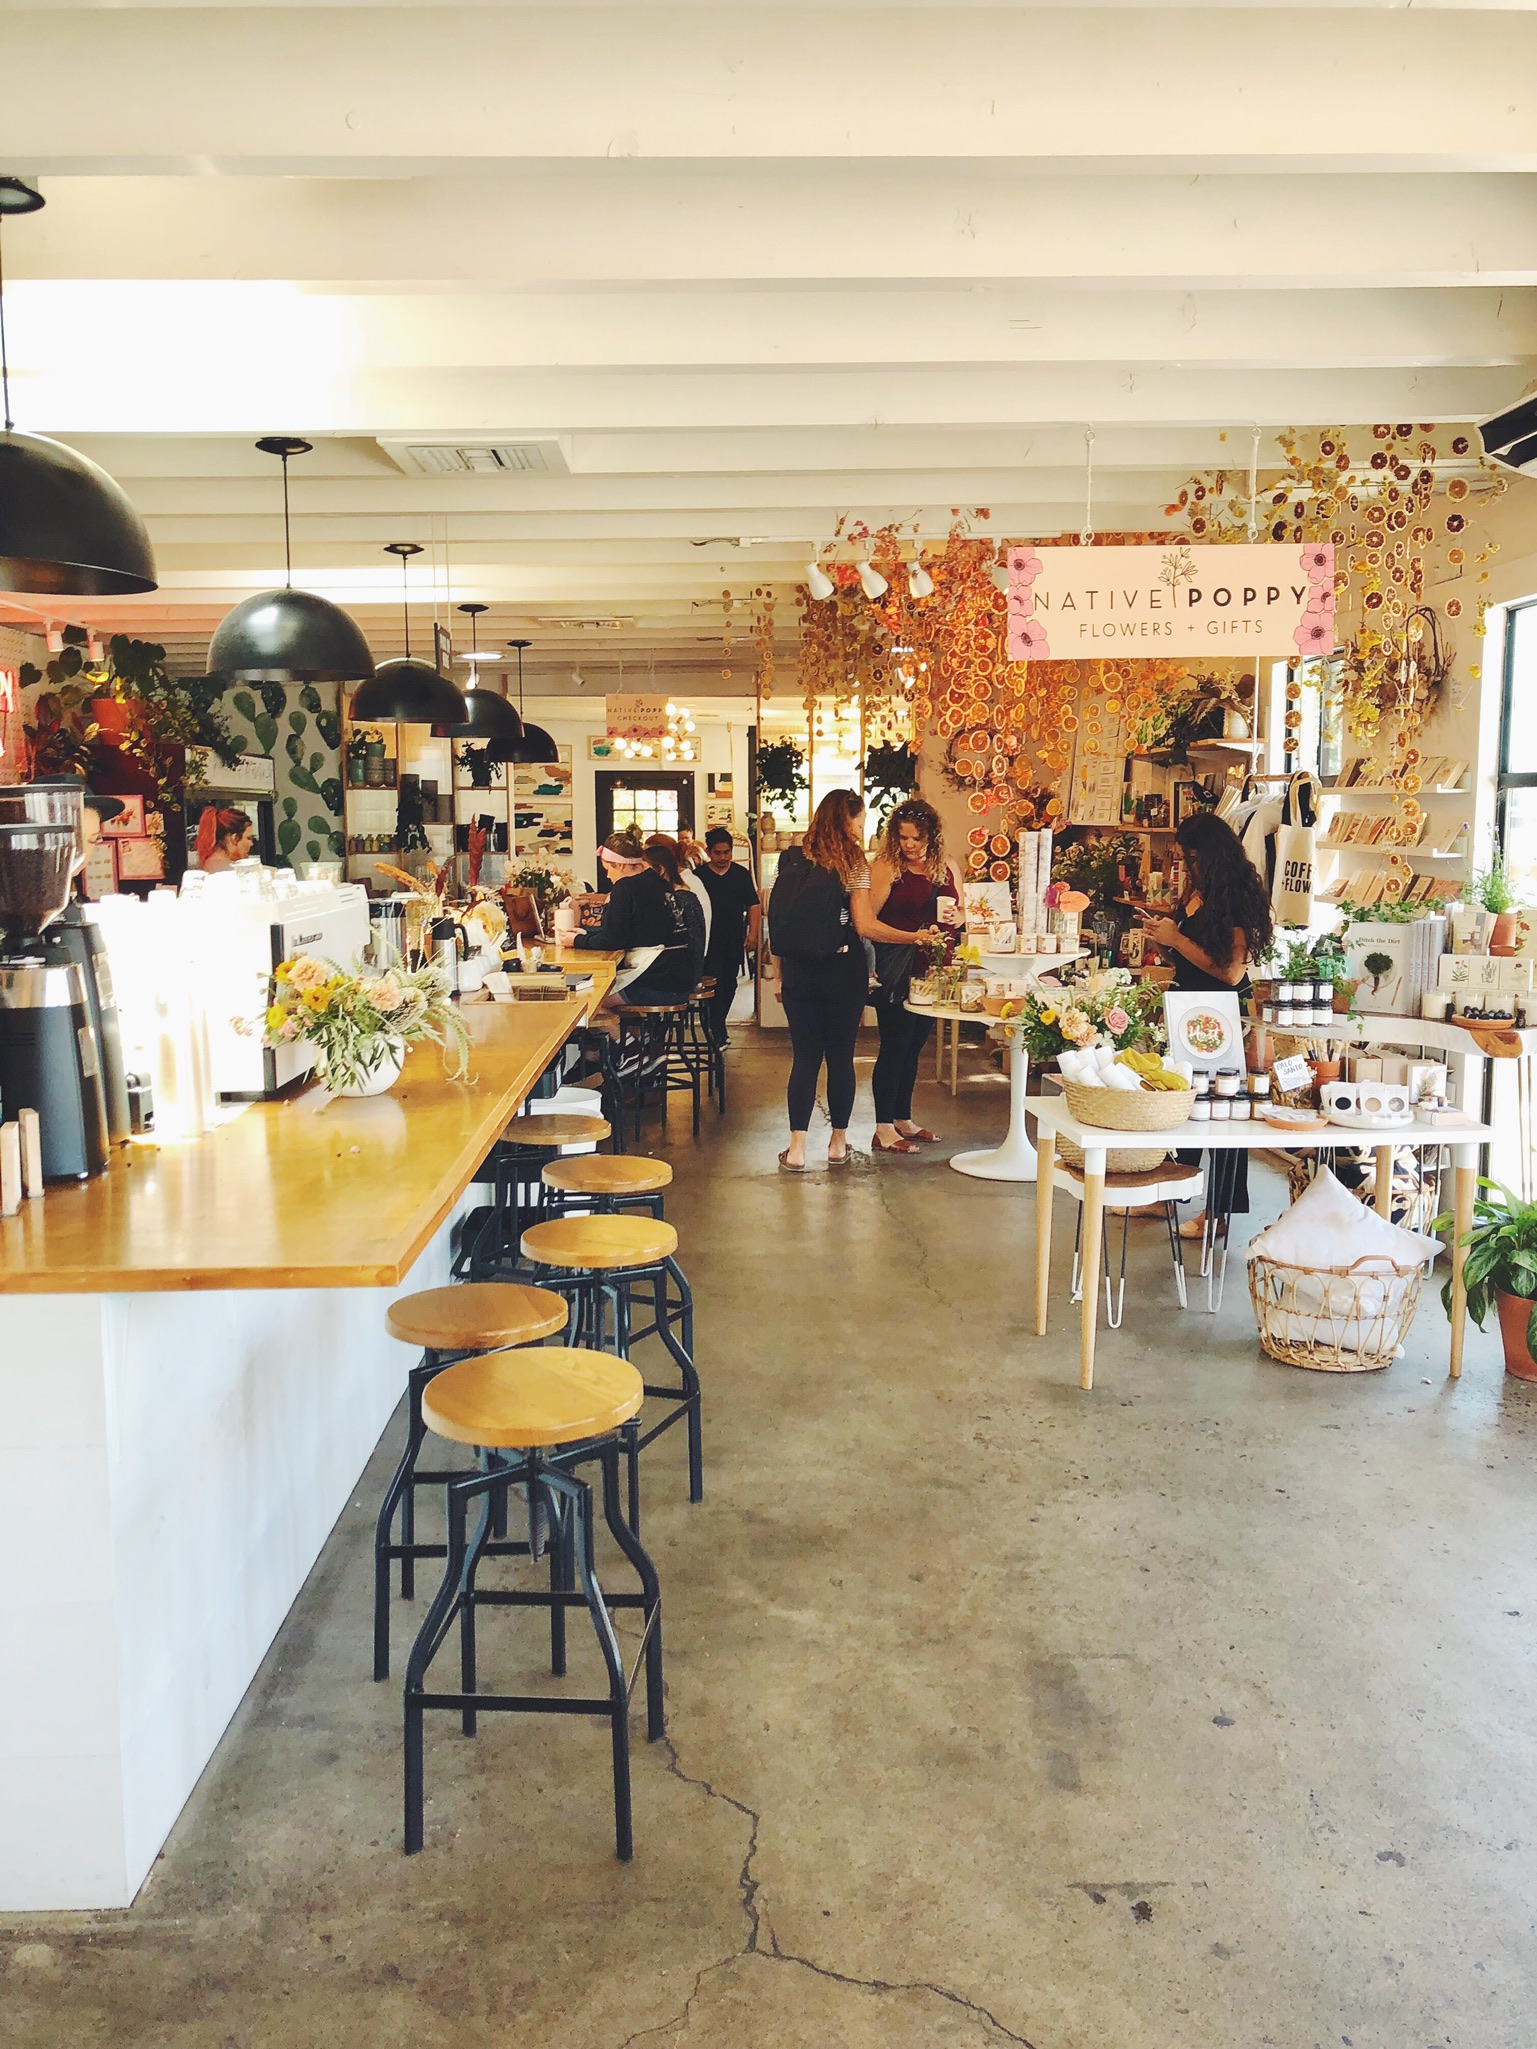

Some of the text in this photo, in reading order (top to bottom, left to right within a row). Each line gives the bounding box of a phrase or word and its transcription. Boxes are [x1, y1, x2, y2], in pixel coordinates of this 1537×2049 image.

[1034, 585, 1308, 611] NATIVE POPPY
[1079, 621, 1174, 638] FLOWERS
[1206, 619, 1264, 635] GIFTS
[1276, 1059, 1293, 1071] PALO
[1283, 1063, 1304, 1075] SANTO
